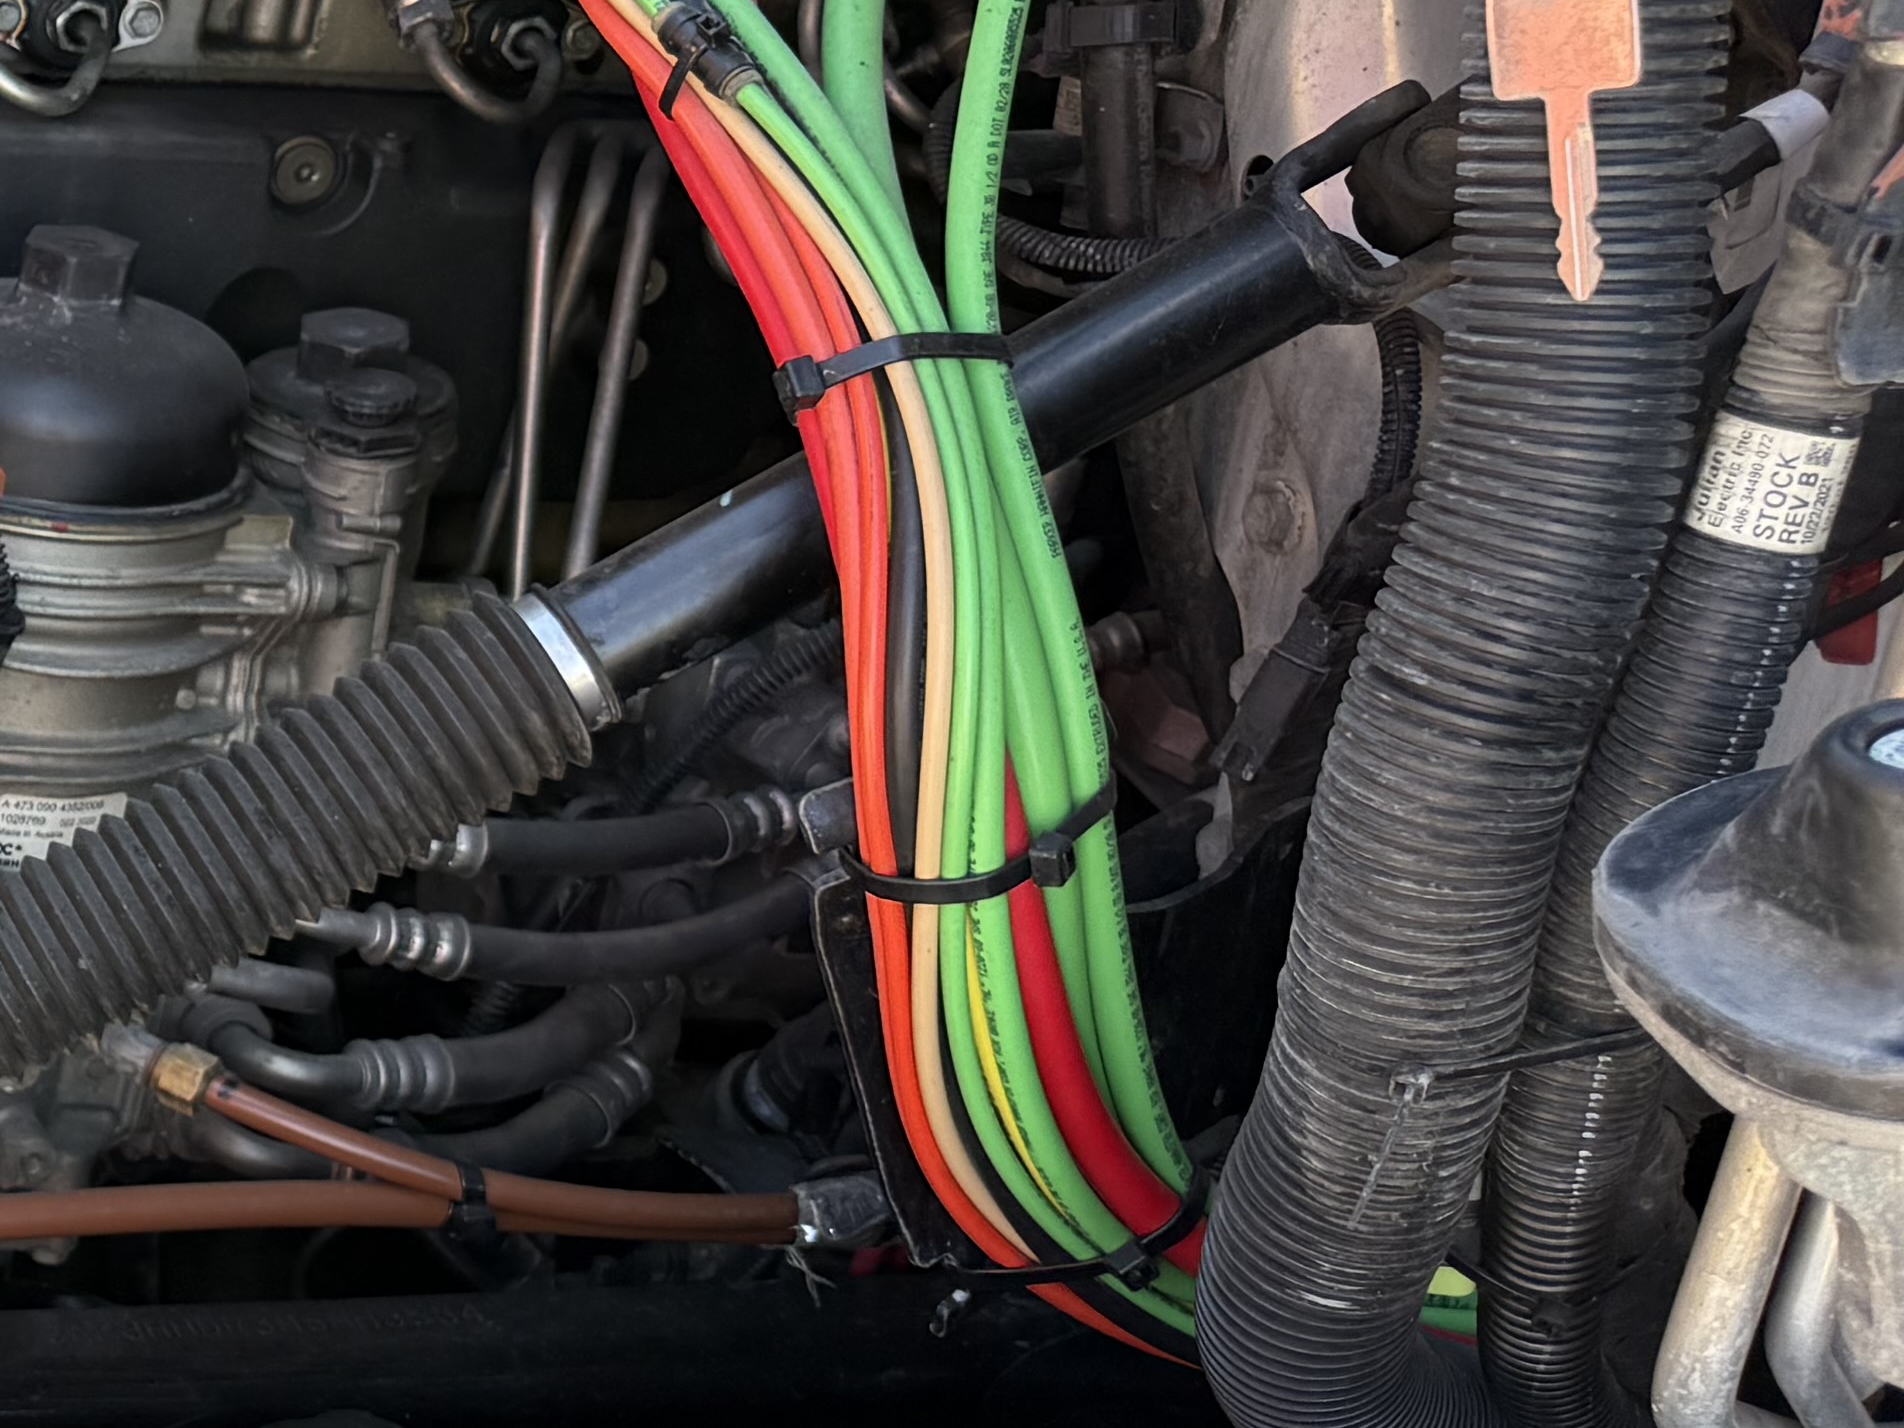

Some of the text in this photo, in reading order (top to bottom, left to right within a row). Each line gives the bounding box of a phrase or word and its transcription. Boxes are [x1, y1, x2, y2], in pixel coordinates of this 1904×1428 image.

[1708, 464, 1741, 528] Electric
[1753, 452, 1800, 540] STOCK
[1778, 471, 1819, 545] REV B
[1084, 684, 1097, 699] IN
[2, 800, 10, 809] A
[14, 801, 34, 811] 473
